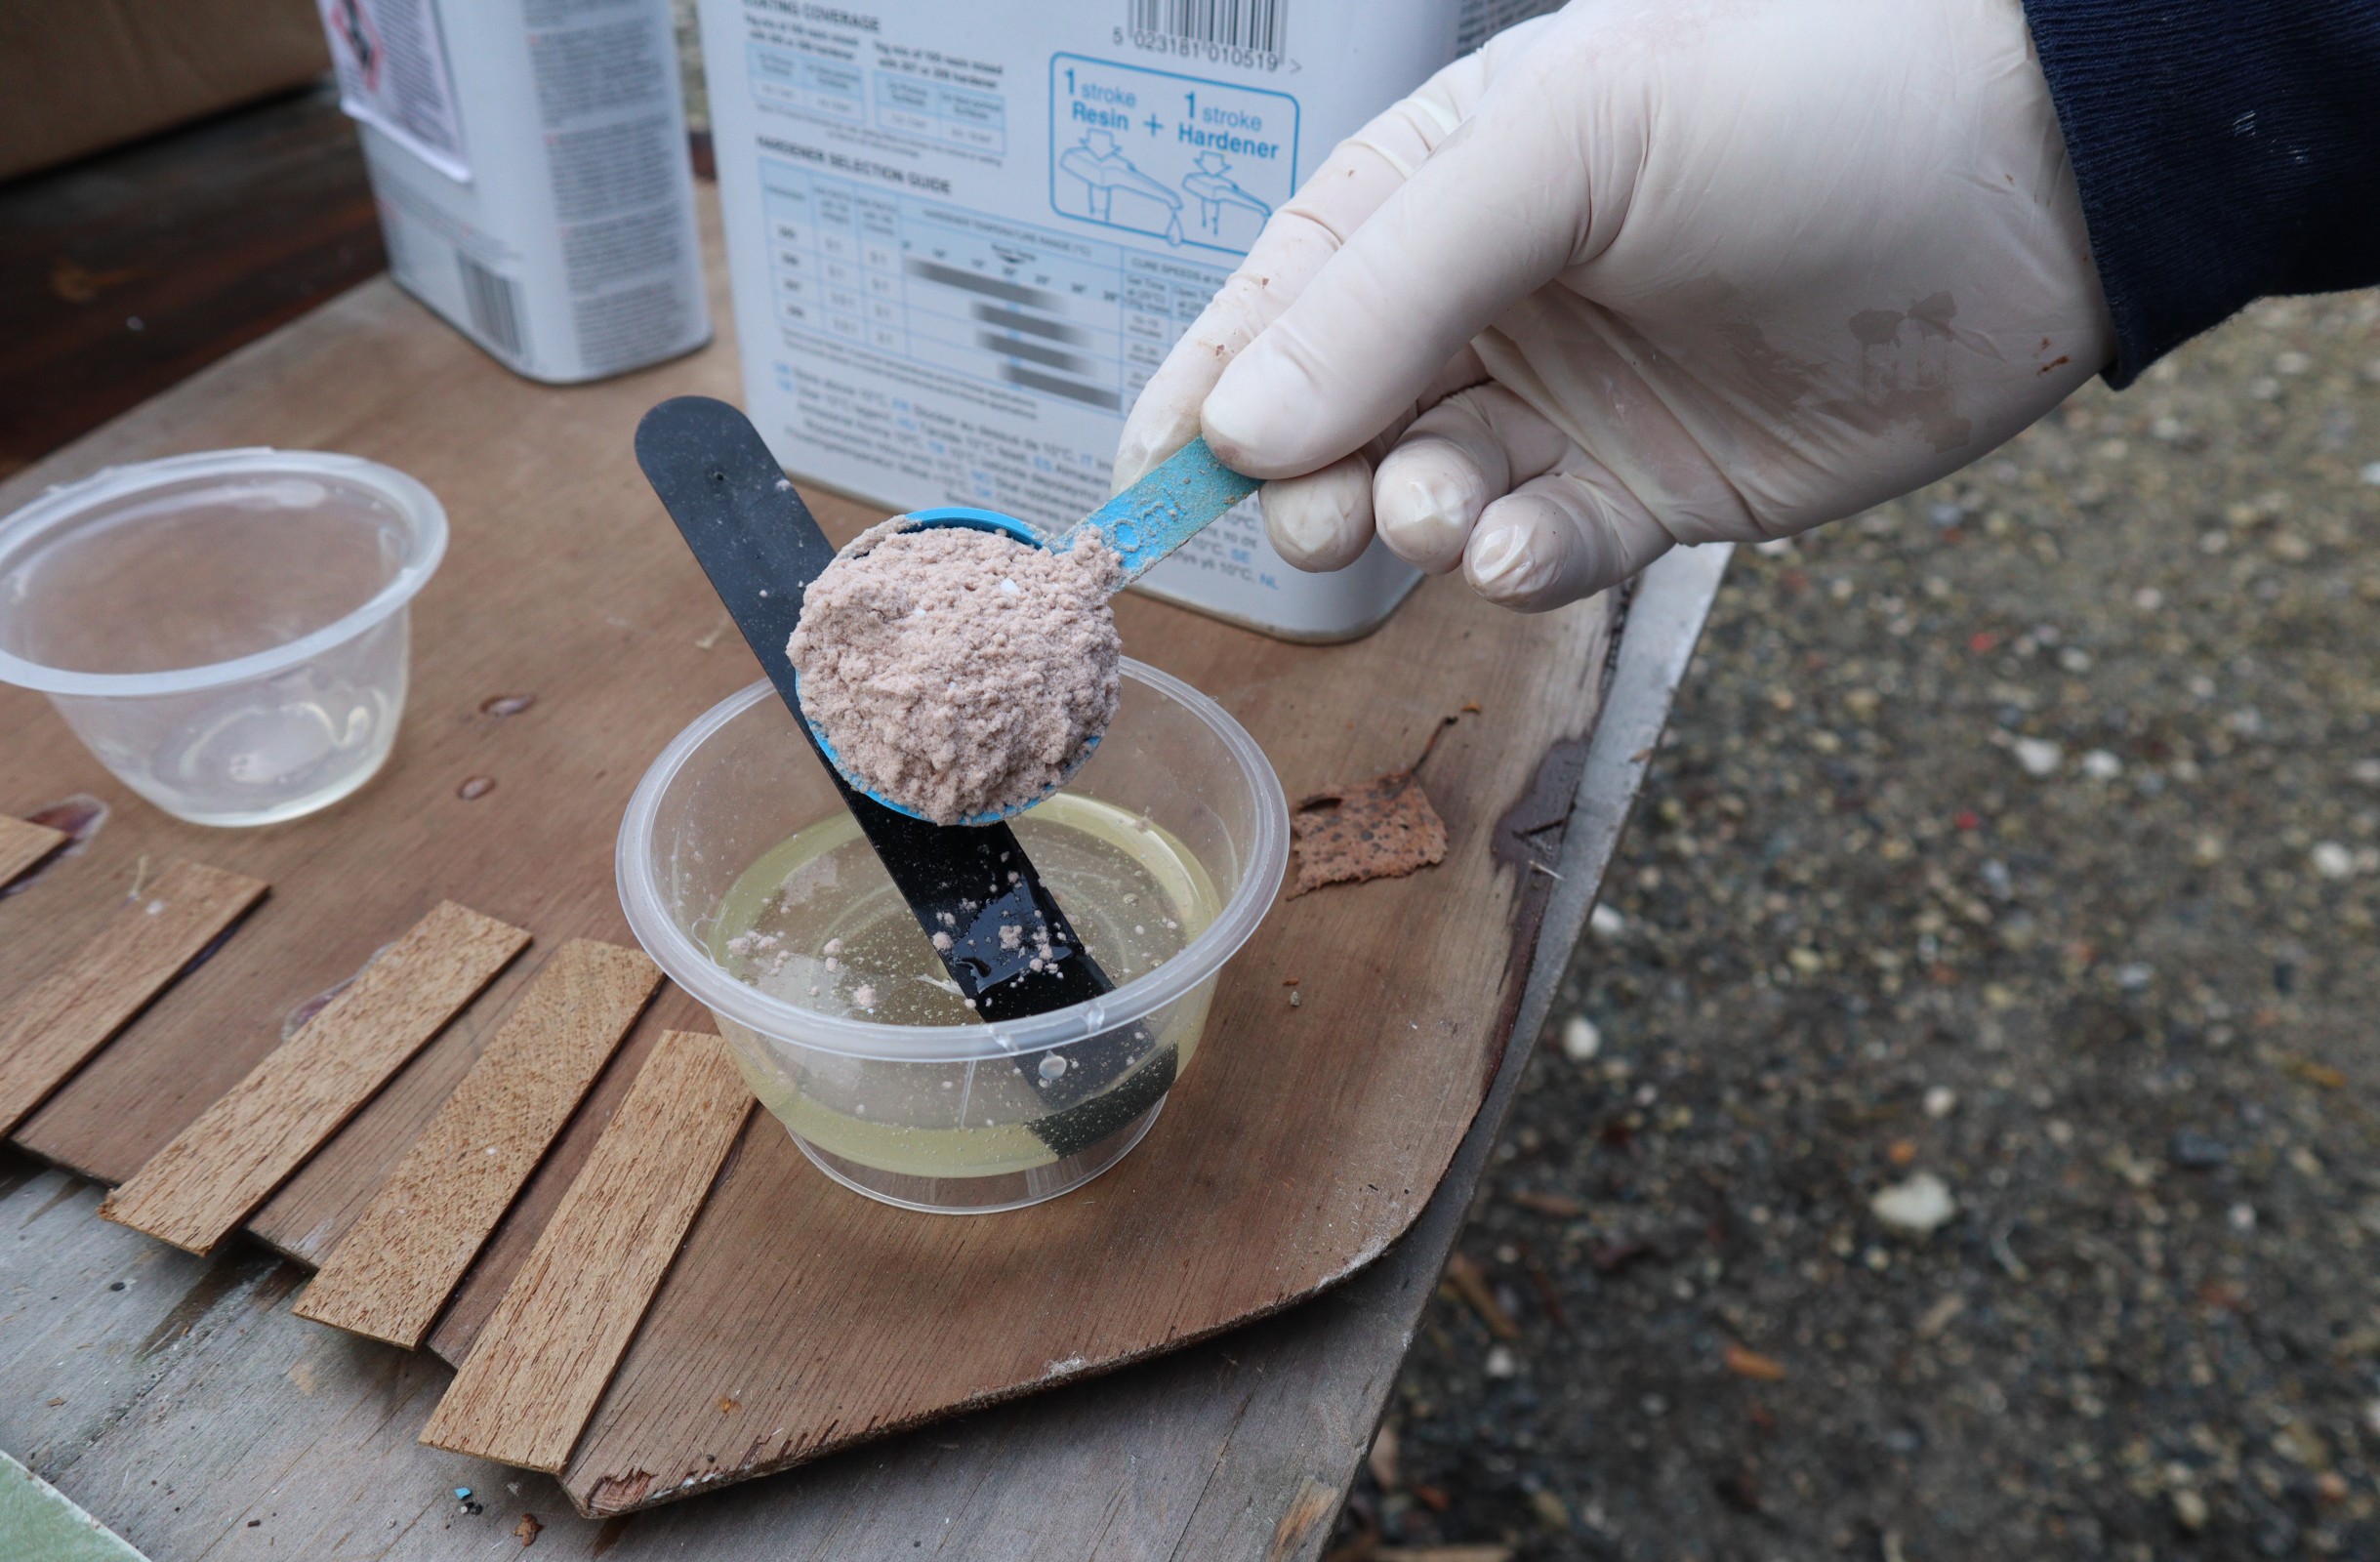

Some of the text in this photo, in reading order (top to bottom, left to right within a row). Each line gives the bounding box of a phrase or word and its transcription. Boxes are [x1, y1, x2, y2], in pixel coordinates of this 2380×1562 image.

[802, 1, 881, 33] COVERAGE
[1112, 26, 1124, 46] 5
[1207, 43, 1279, 72] 010519
[1064, 67, 1137, 108] 1 stroke
[1072, 101, 1130, 131] Resin
[1177, 121, 1281, 160] Hardener
[1184, 91, 1263, 133] 1 stroke
[755, 135, 826, 163] HARDENER
[829, 150, 905, 184] SELECTION
[907, 170, 952, 194] GUIDE
